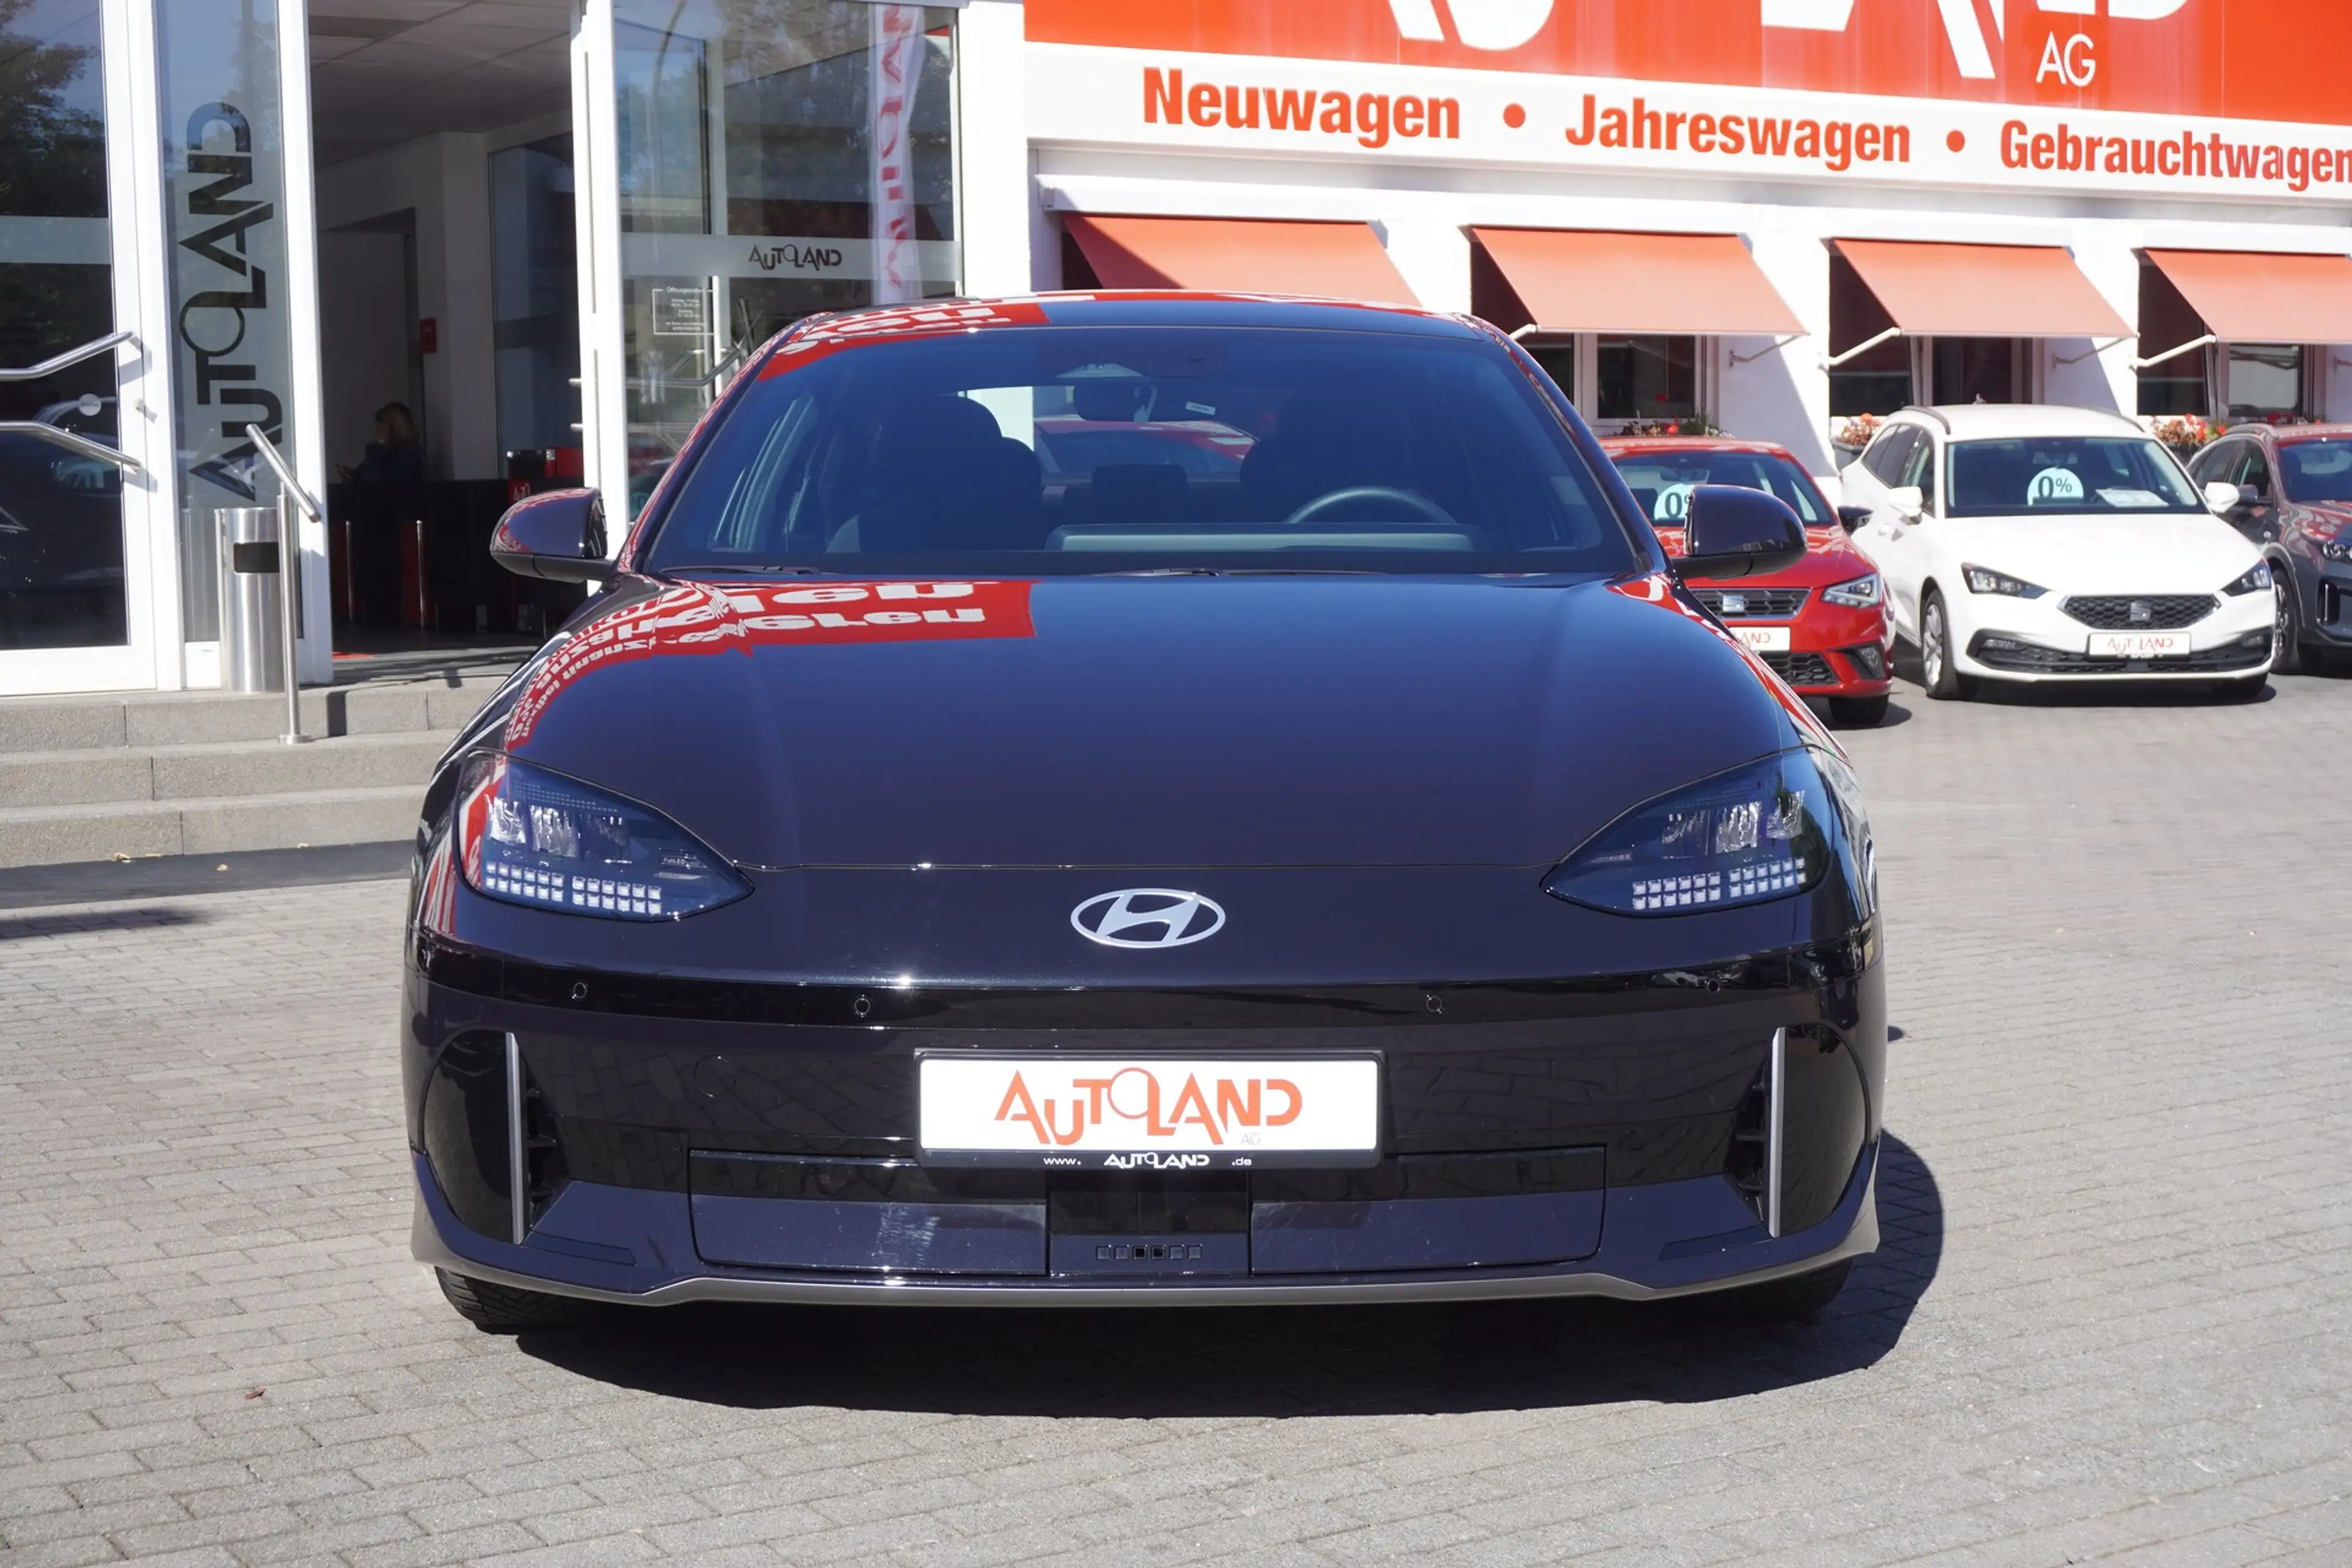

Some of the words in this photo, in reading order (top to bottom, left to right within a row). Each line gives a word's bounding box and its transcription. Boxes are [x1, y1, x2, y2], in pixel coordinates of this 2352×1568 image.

[2036, 31, 2096, 86] AG
[1143, 67, 1460, 149] Neuwagen
[1564, 94, 1910, 172] Jahreswagen
[2000, 120, 2352, 192] Gebrauchtwagen
[748, 243, 842, 271] AUTOLAND
[178, 101, 283, 502] AUTOLAND
[2038, 476, 2073, 498] 0%
[995, 1067, 1303, 1145] AUTOLAND
[1043, 1157, 1082, 1166] www.
[1103, 1152, 1210, 1169] AUTOLAND
[1231, 1155, 1252, 1166] .de
